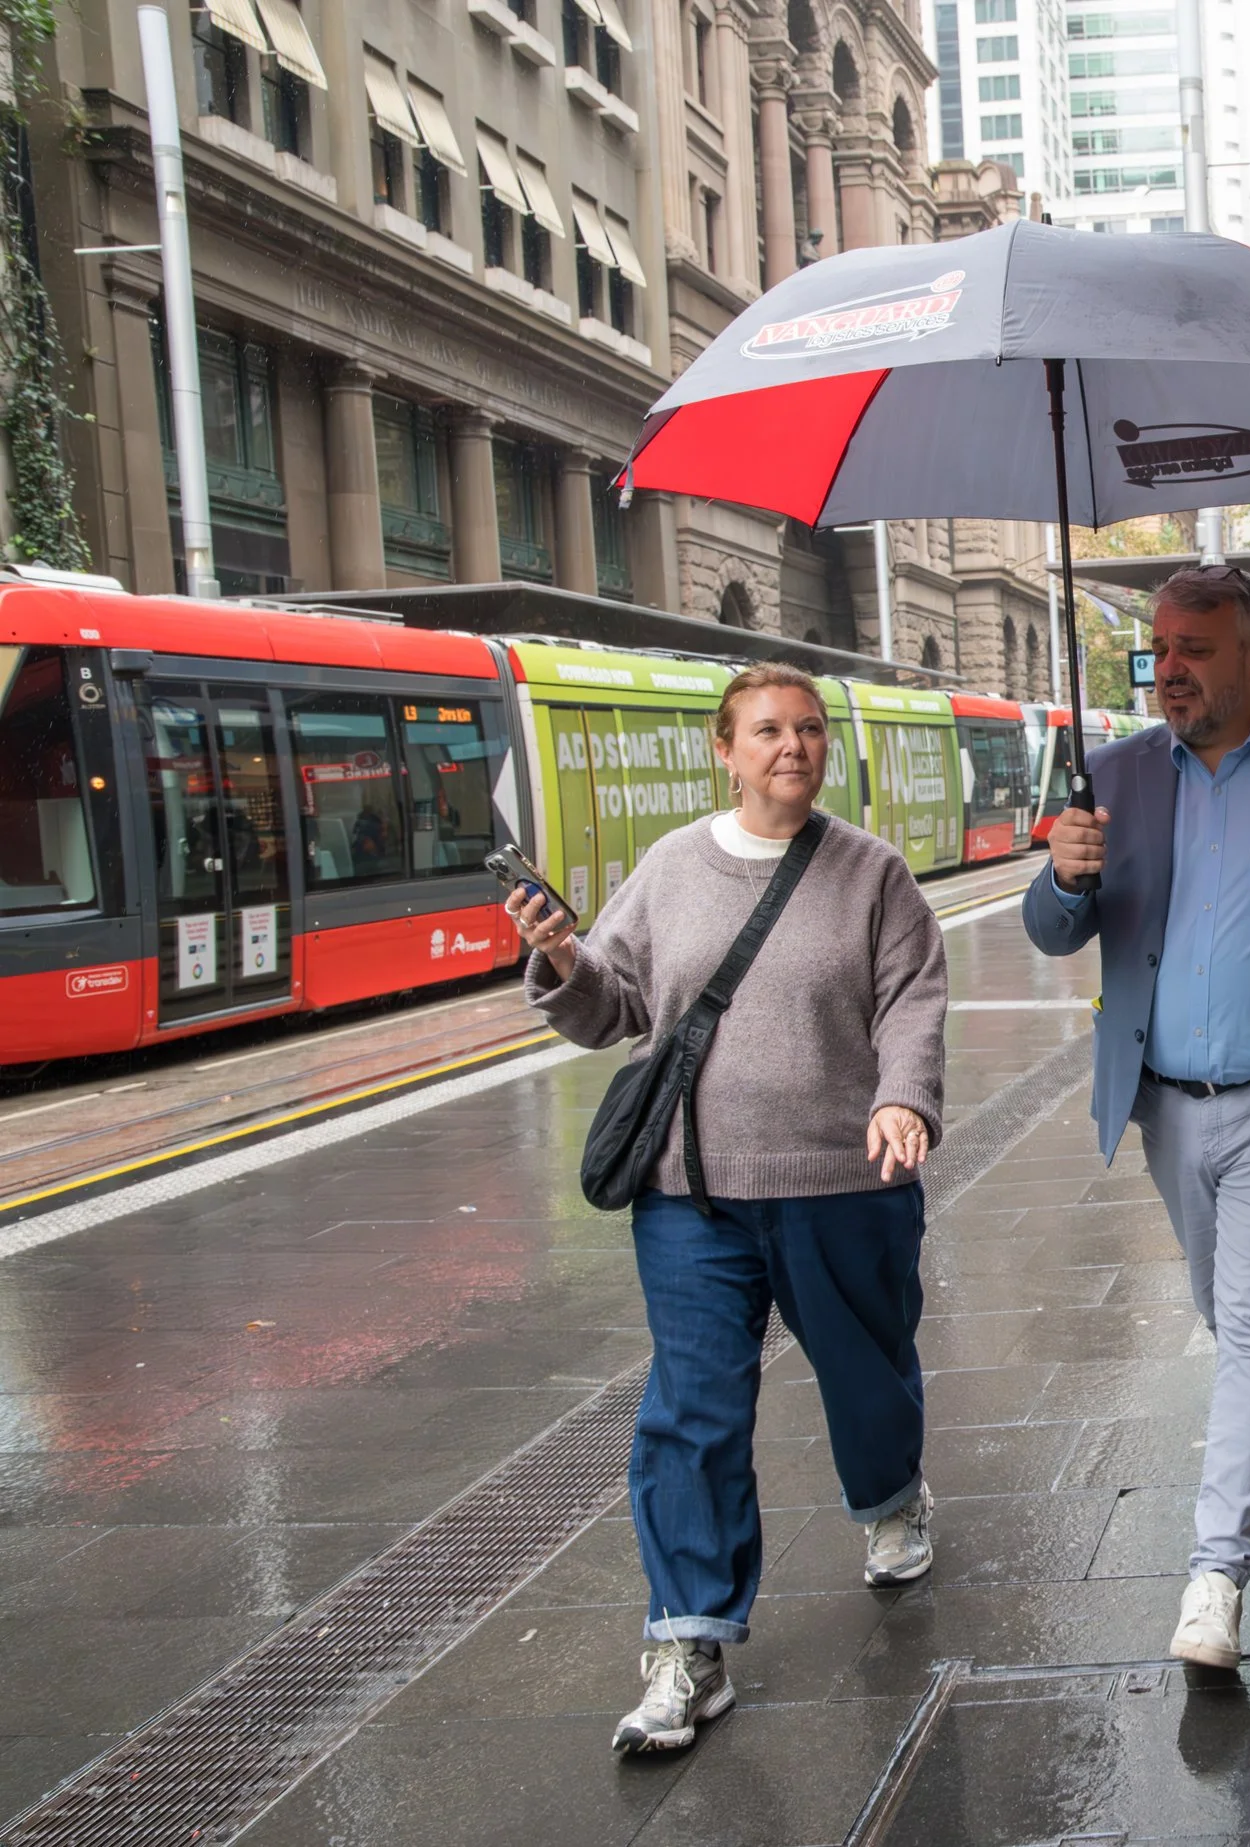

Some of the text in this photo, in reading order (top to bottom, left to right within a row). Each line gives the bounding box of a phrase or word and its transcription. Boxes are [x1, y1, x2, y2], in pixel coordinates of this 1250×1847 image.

[764, 294, 952, 345] VANGUARD
[805, 313, 950, 348] logistics services
[80, 667, 92, 679] B
[557, 732, 605, 770] ADD
[605, 732, 661, 769] SOME
[596, 778, 713, 819] TO YOUR RIDE!
